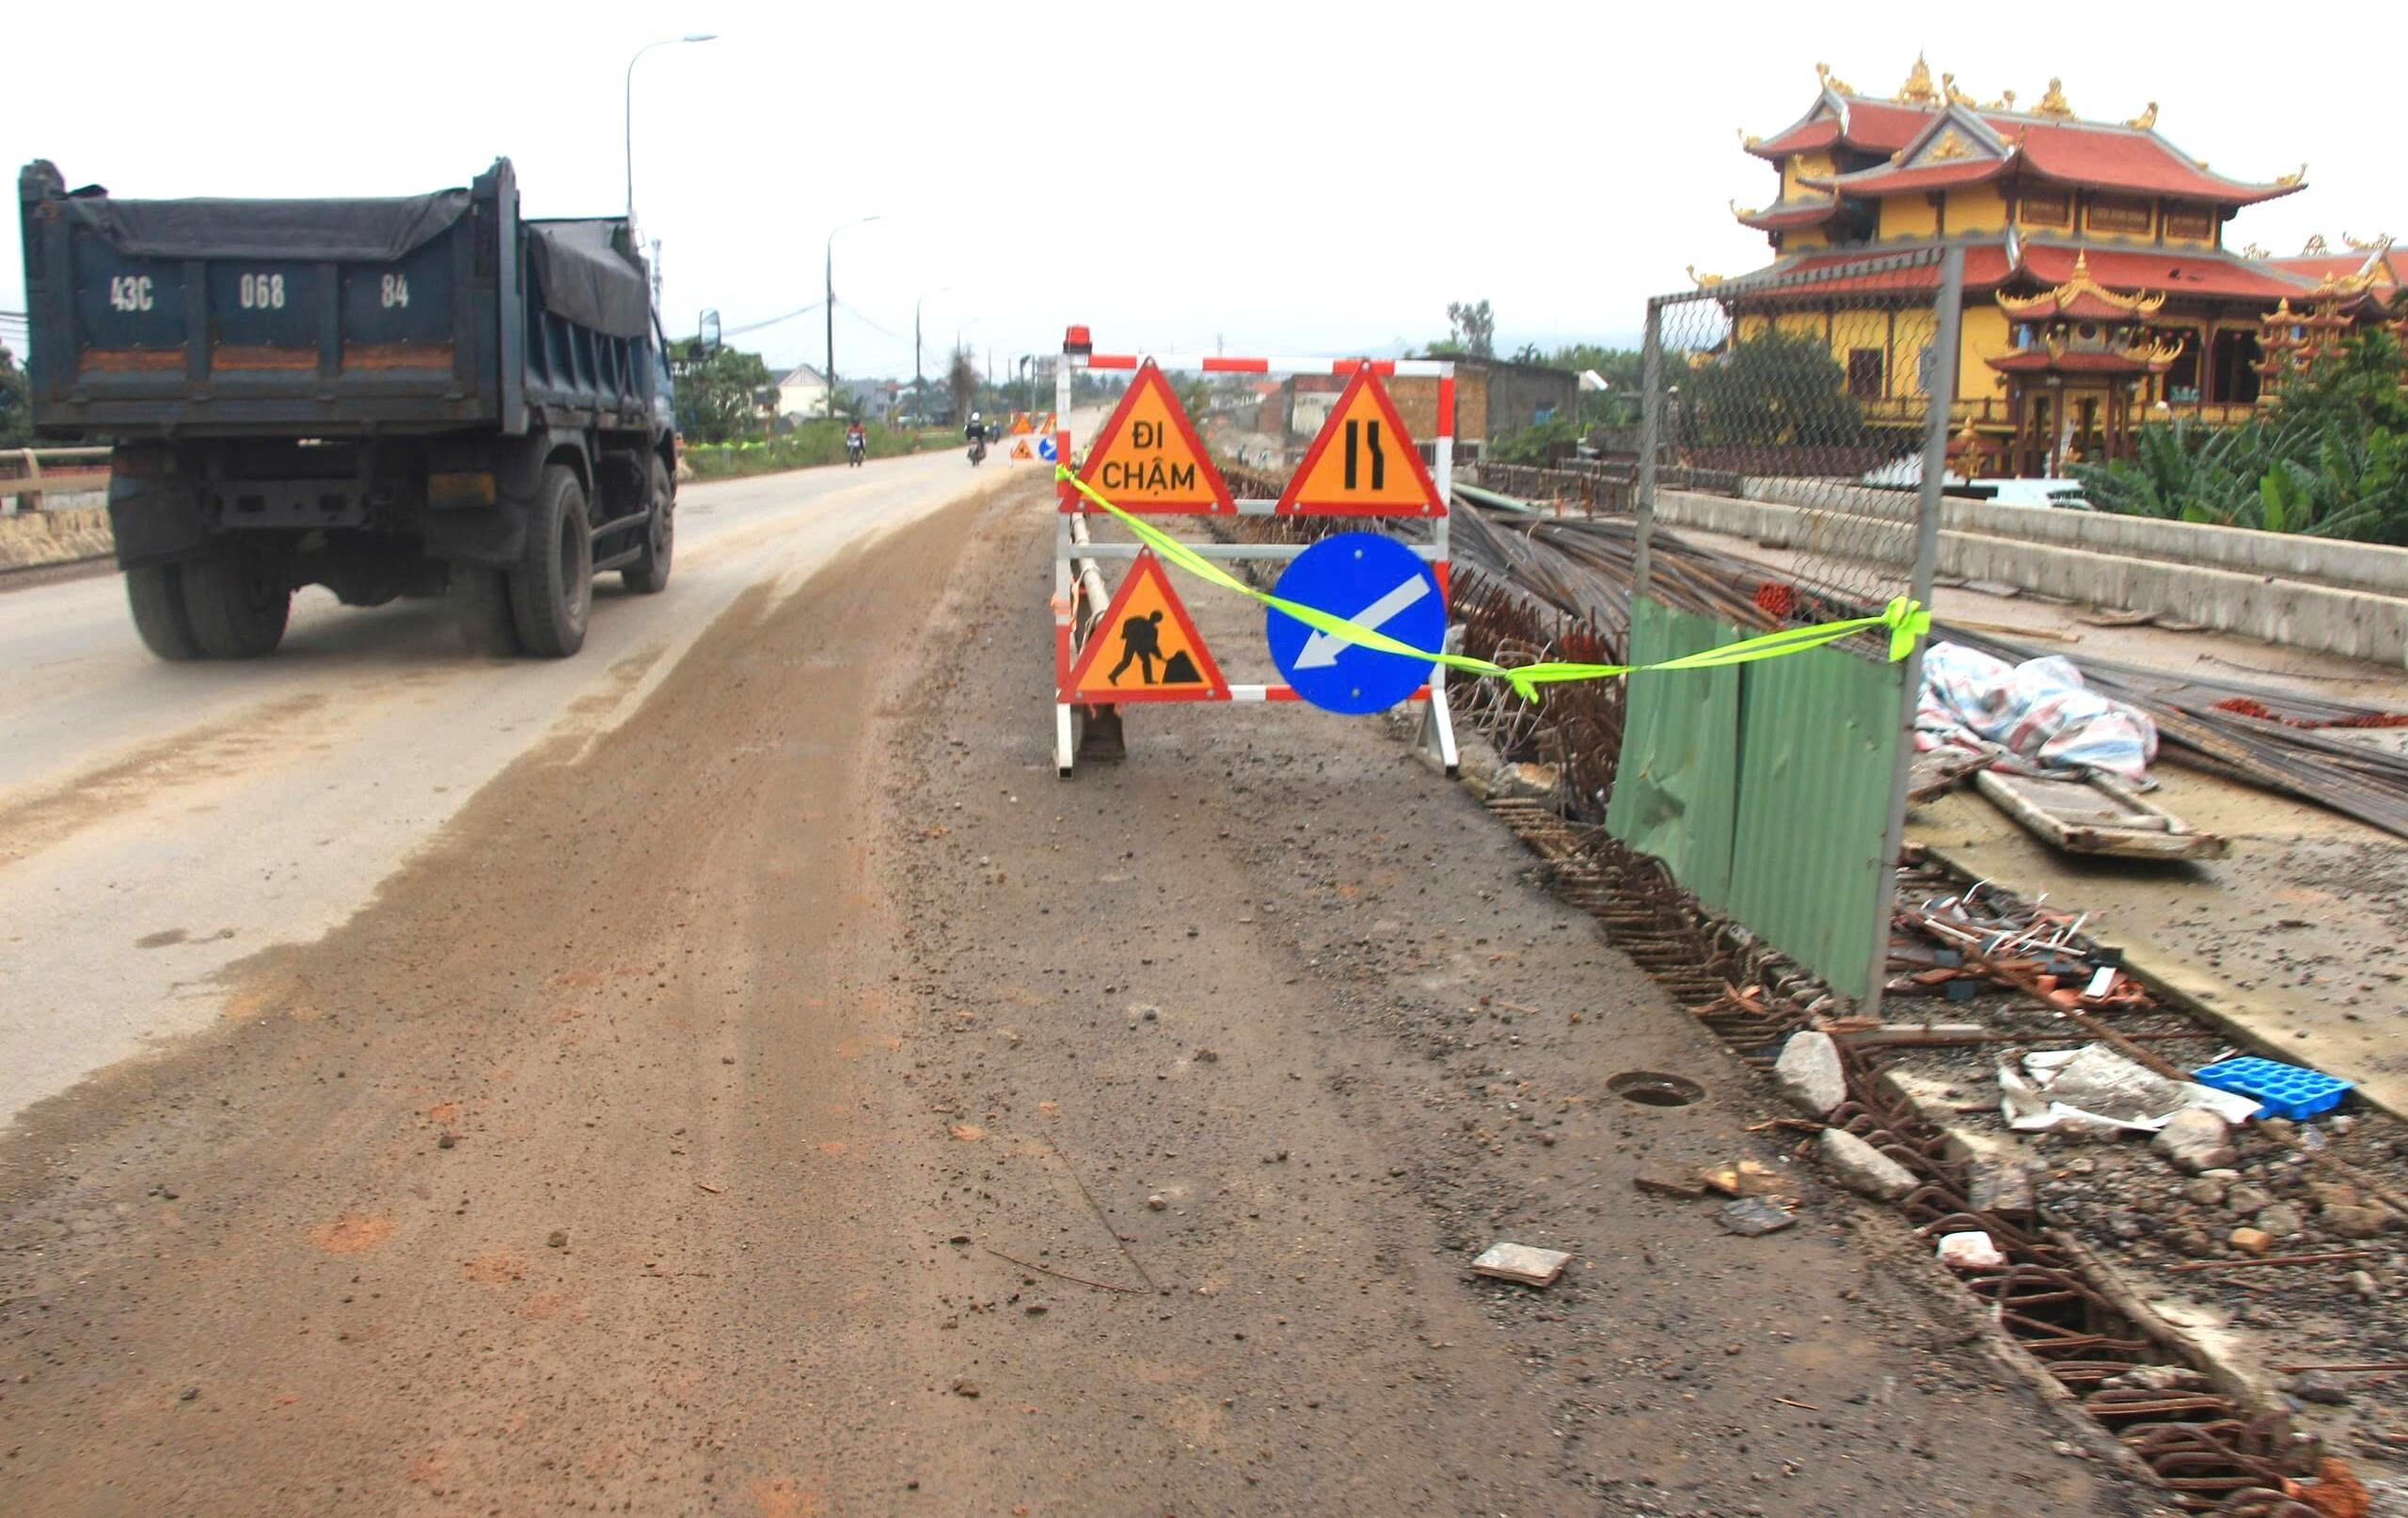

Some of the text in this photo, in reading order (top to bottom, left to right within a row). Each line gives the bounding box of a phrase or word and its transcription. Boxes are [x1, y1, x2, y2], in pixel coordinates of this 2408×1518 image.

[110, 274, 409, 311] 43C 068 84
[1132, 420, 1163, 449] ĐI
[1101, 456, 1195, 496] CHẬM
